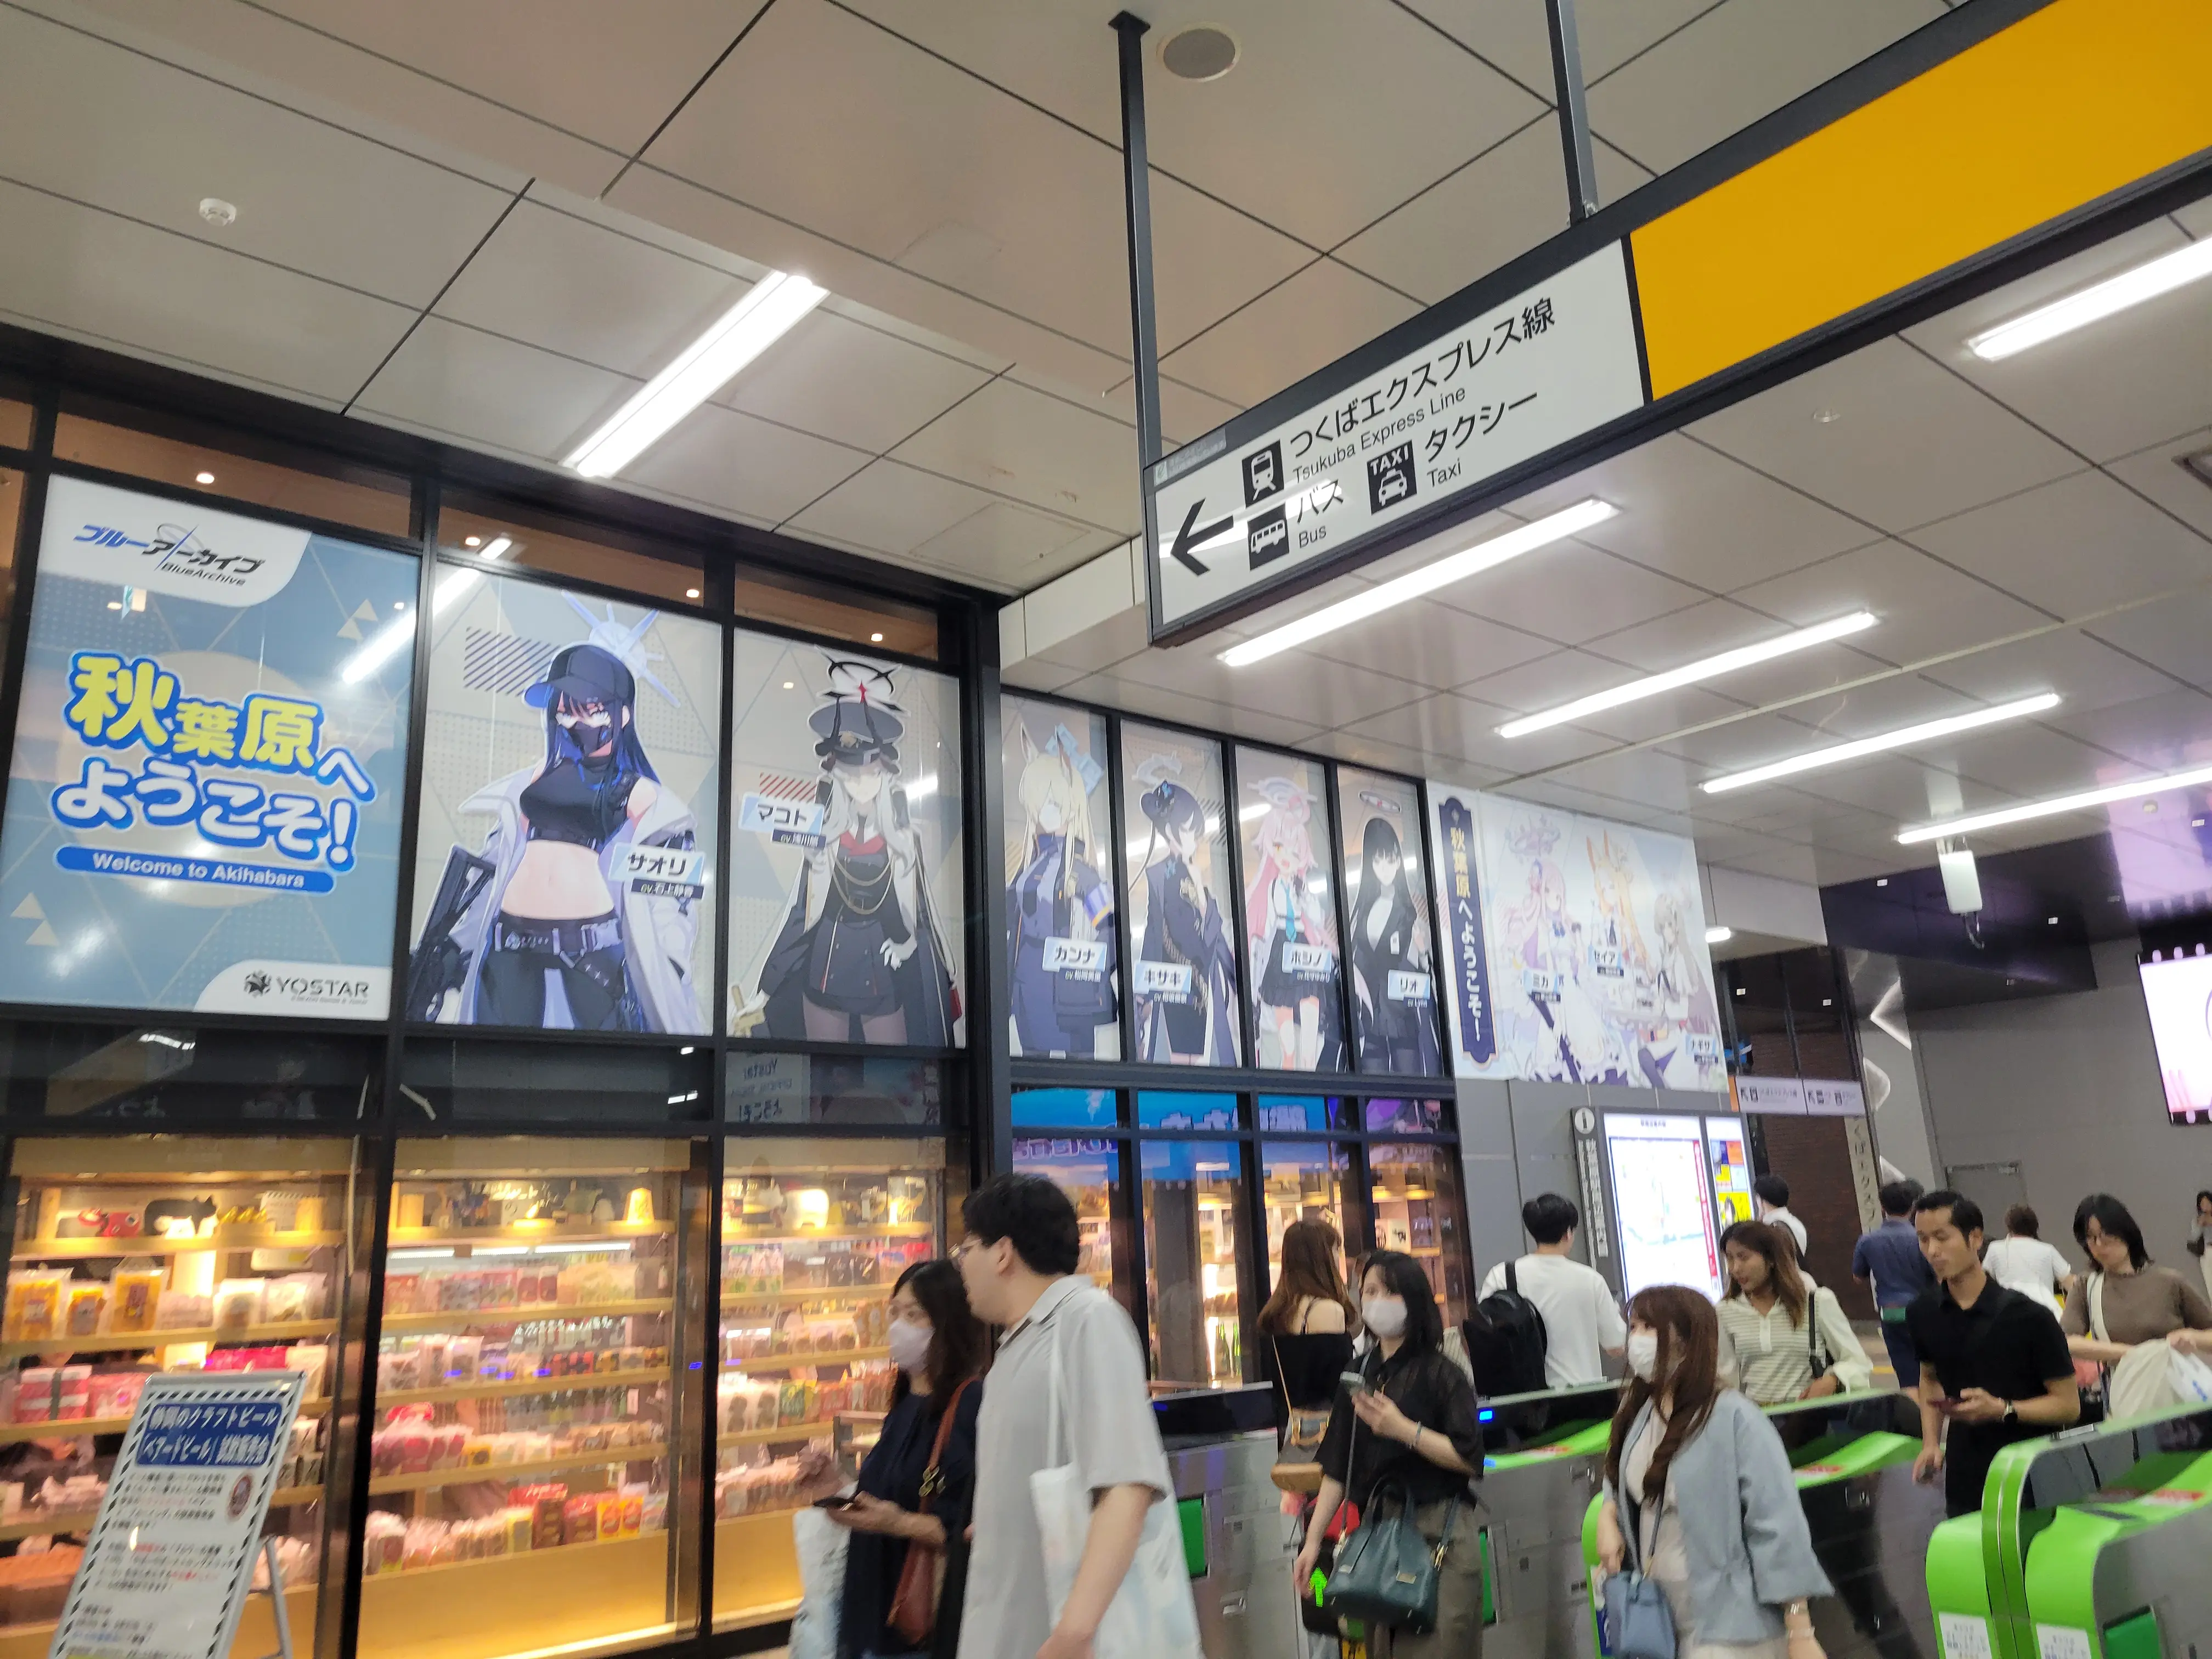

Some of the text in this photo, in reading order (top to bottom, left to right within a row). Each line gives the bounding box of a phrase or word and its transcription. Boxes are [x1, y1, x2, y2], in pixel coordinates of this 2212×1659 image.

[1290, 297, 1555, 459] つくばエクスプレス線
[1293, 387, 1465, 484] Tsukuba Express Line
[1424, 392, 1537, 464] タクシー
[1370, 443, 1409, 475] TAXI
[1426, 457, 1462, 488] Taxi
[1297, 478, 1344, 524] バス
[73, 523, 266, 573] ブルーアーカイブ
[1298, 526, 1327, 548] Bus
[160, 561, 247, 586] BlueArchive
[67, 653, 373, 798] 秋葉原へ
[54, 758, 358, 868] ようこそ!
[757, 803, 807, 827] マコト
[92, 851, 306, 889] Welcome to Akihabara
[628, 852, 687, 876] サオリ
[1053, 945, 1095, 966] カンナ
[1291, 949, 1322, 967] ホシノ
[276, 975, 370, 998] YOSTAR
[1144, 969, 1182, 988] キサキ
[1400, 977, 1419, 994] リオ
[1533, 974, 1549, 989] ミカ
